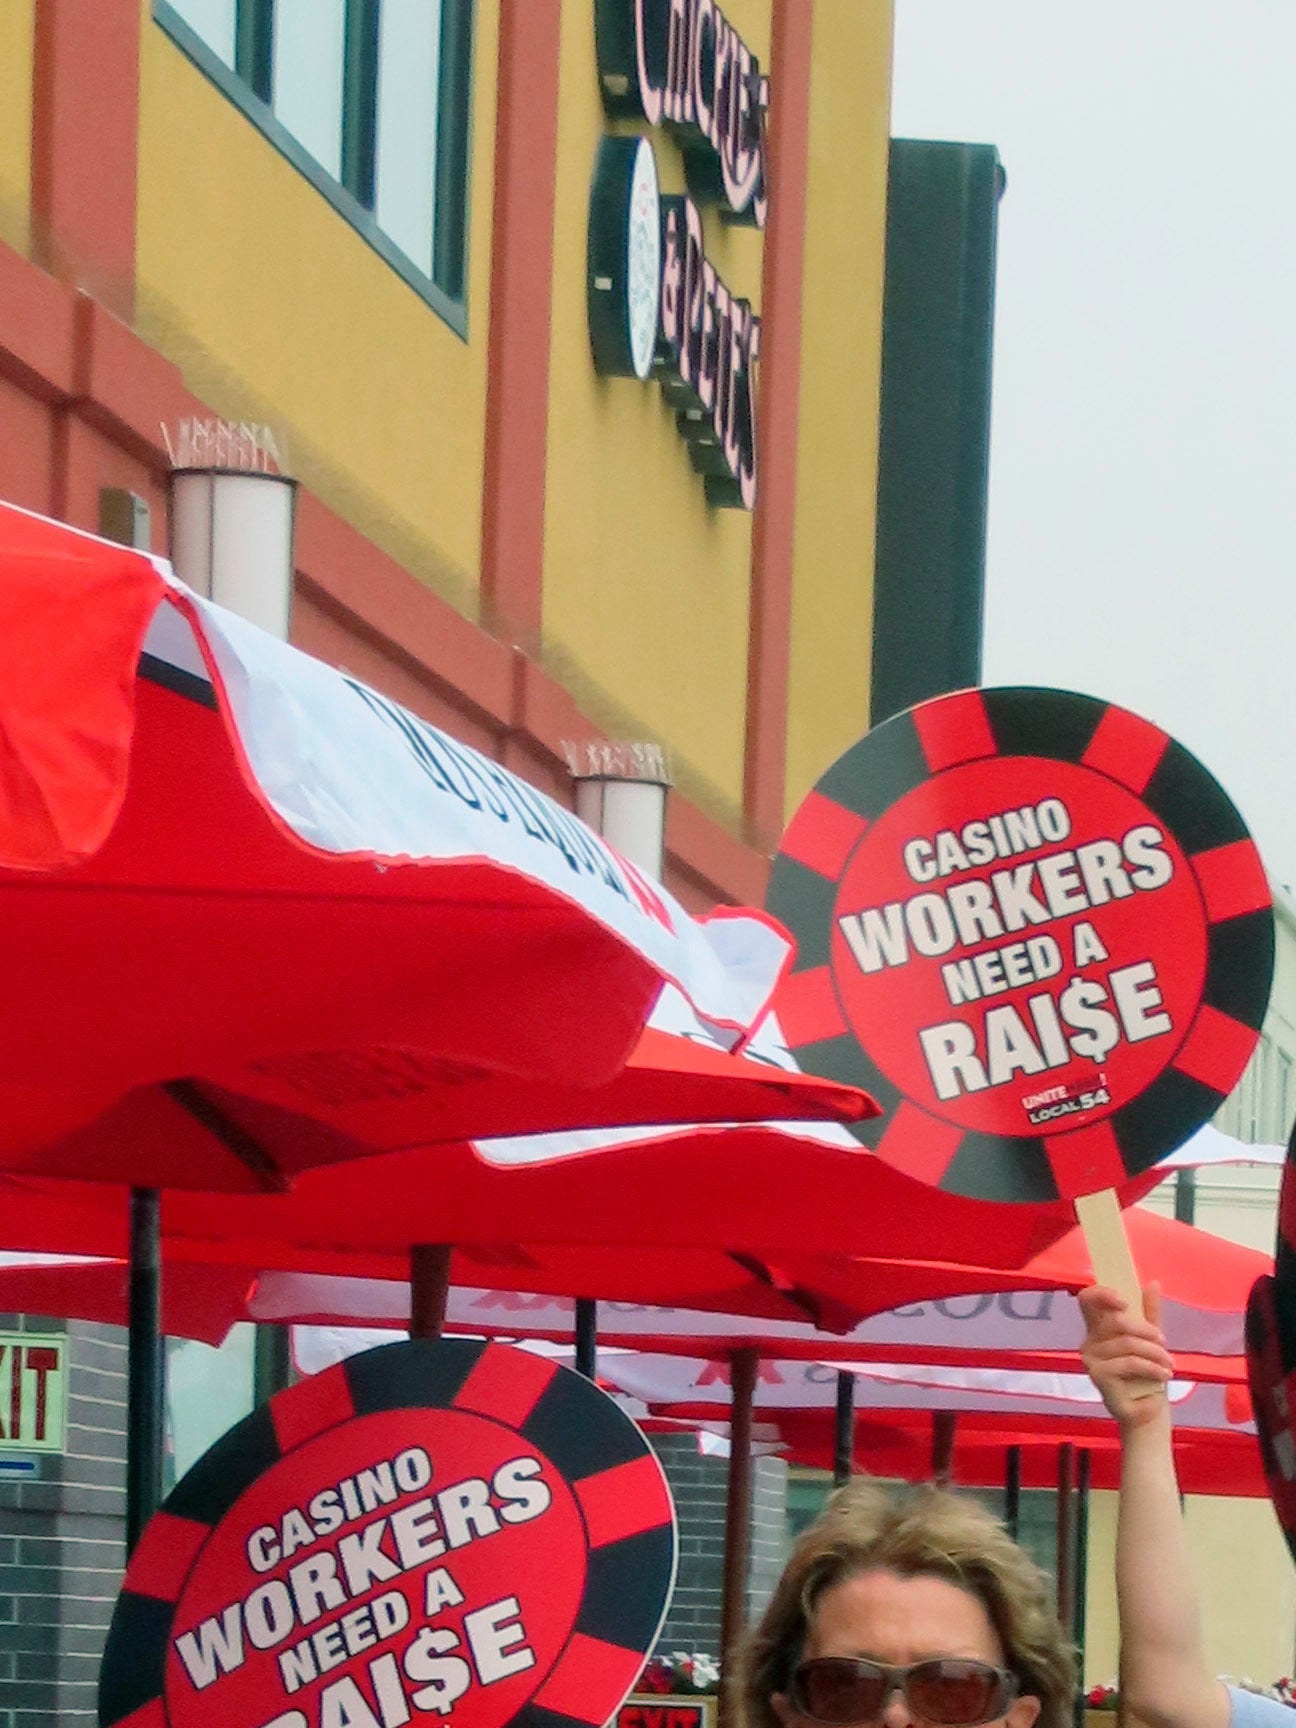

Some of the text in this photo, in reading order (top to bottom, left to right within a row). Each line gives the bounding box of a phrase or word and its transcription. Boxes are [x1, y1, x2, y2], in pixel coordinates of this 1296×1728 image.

[838, 825, 1174, 973] WORKERS
[903, 796, 1071, 883] CASINO
[942, 922, 1108, 1006] NEED A
[920, 961, 1172, 1101] RAI$E
[1029, 1088, 1111, 1123] LOCAL 54
[246, 1446, 432, 1574] CASINO
[174, 1457, 552, 1692] WORKERS
[278, 1569, 464, 1694] NEED A
